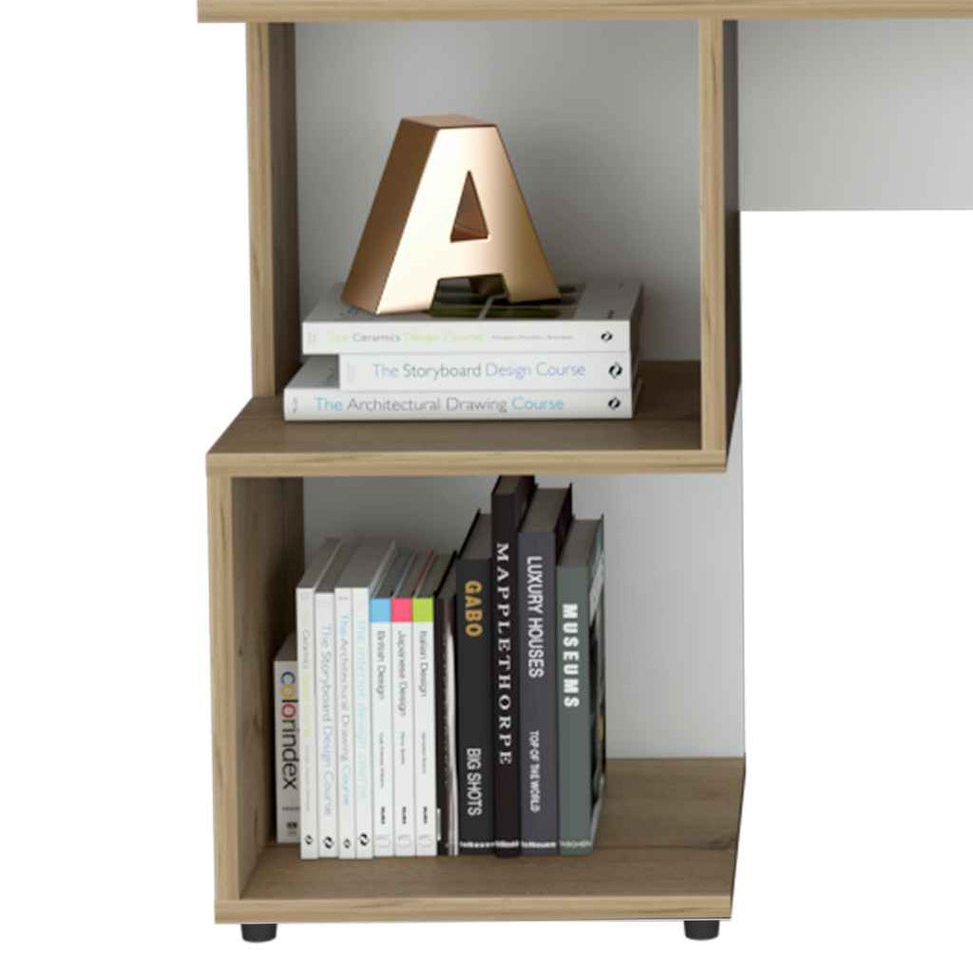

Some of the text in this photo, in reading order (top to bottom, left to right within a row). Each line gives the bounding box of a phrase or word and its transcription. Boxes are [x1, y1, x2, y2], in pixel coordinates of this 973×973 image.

[352, 115, 562, 316] A
[352, 331, 401, 342] Ceramics
[373, 361, 586, 381] The Storyboard Design Course
[315, 396, 343, 411] The
[347, 397, 440, 412] Architectural
[446, 397, 508, 413] Drawing
[512, 395, 564, 411] Course
[465, 580, 483, 637] GABO
[526, 556, 544, 678] LUXURY HOUSES
[321, 651, 333, 722] Storyboard
[376, 630, 386, 700] British Design
[398, 630, 408, 717] Japanese Design
[419, 662, 429, 697] Design
[496, 542, 512, 765] MAPPLETHORPE
[562, 603, 580, 708] MUSEUMS
[280, 671, 299, 789] colorindex
[322, 727, 333, 766] Design
[467, 748, 482, 816] BIG SHOTS
